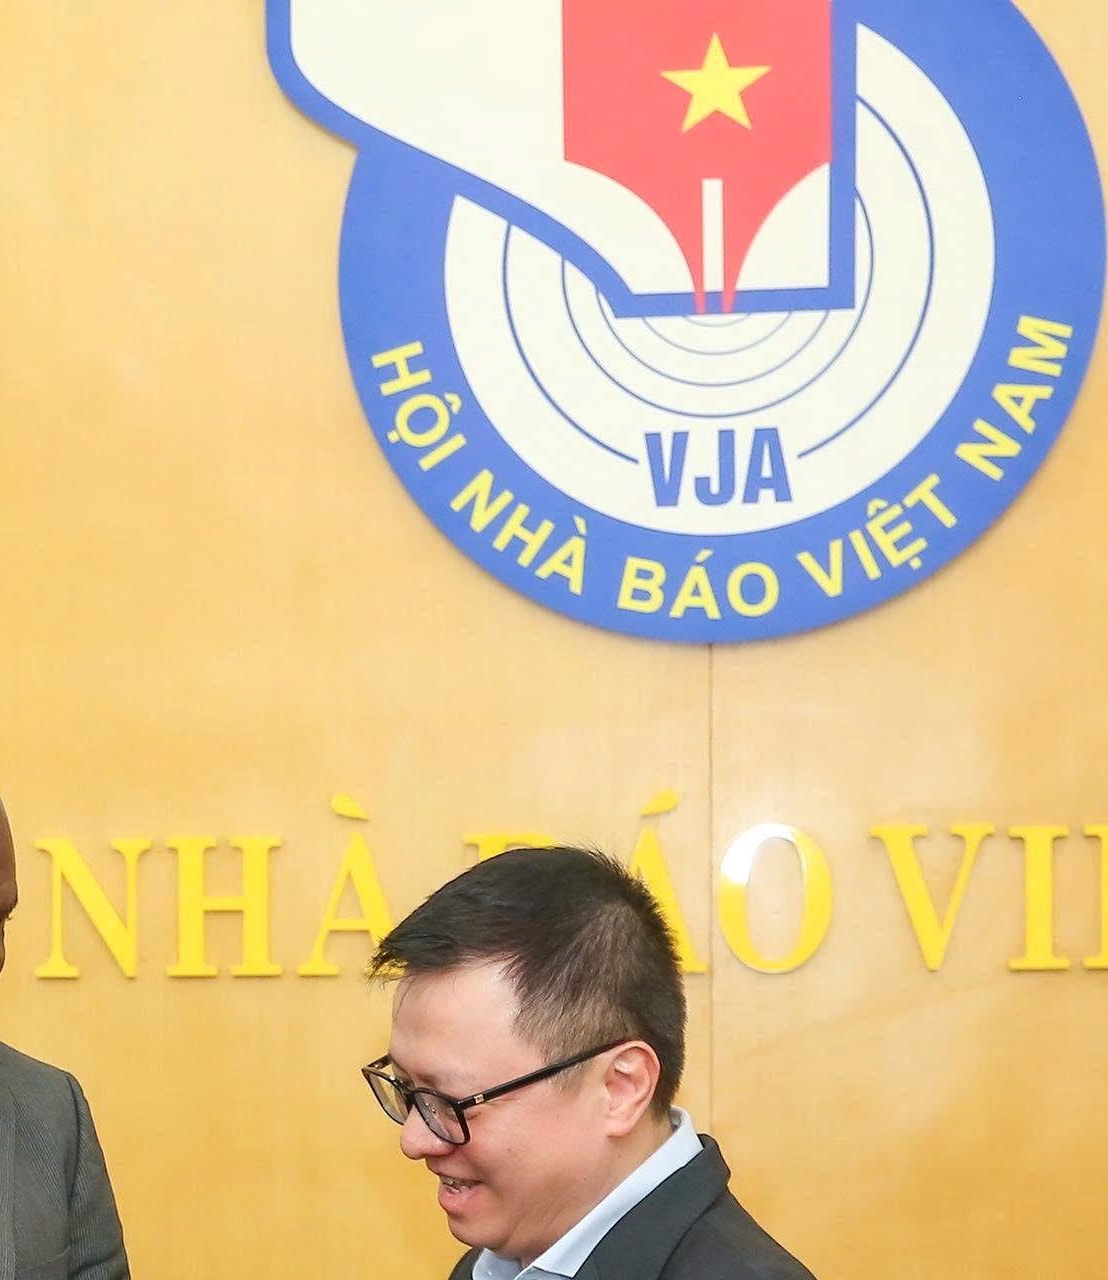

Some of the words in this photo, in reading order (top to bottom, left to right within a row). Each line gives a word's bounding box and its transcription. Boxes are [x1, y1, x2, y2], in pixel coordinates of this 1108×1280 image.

[371, 341, 466, 472] HỘI
[449, 471, 590, 596] NHÀ
[617, 550, 780, 620] BÁO
[797, 475, 958, 599] VIỆT
[955, 314, 1074, 482] NAM
[644, 427, 793, 508] VJA
[35, 793, 406, 978] NHÀ
[869, 821, 1108, 971] VI
